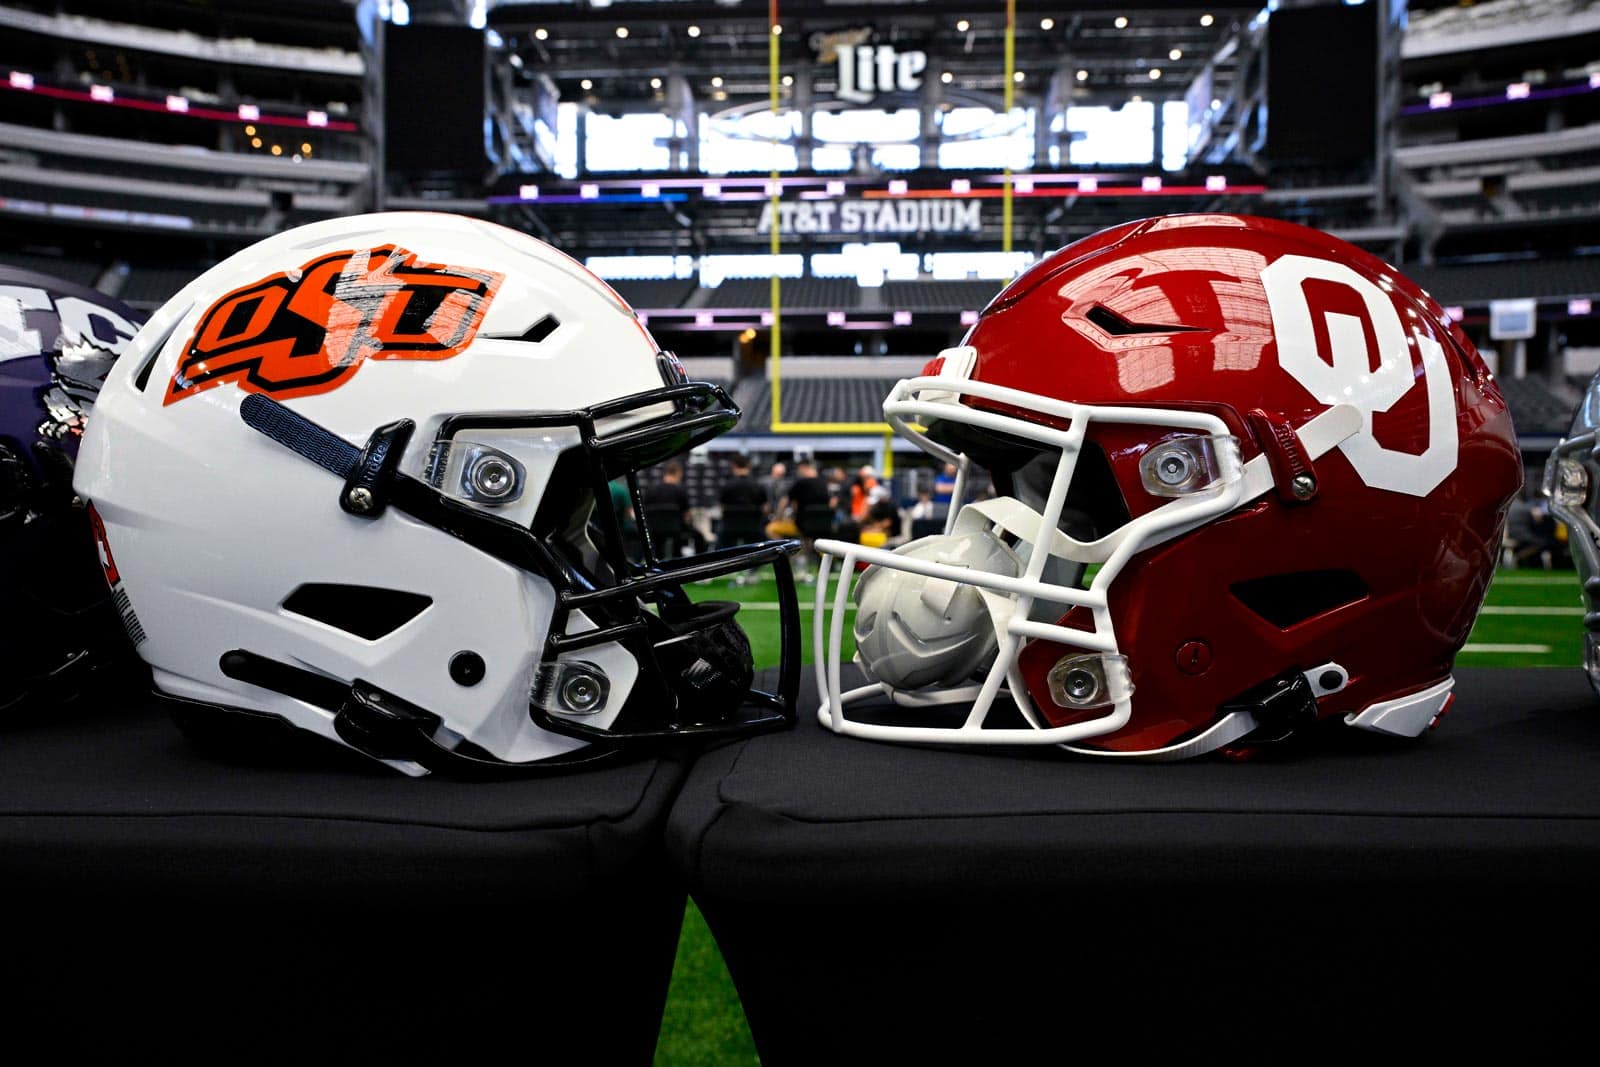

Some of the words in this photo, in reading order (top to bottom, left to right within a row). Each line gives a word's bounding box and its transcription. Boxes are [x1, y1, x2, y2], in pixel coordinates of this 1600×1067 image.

[833, 44, 927, 104] Lite
[757, 200, 836, 233] AT&T
[840, 199, 983, 233] STADIUM
